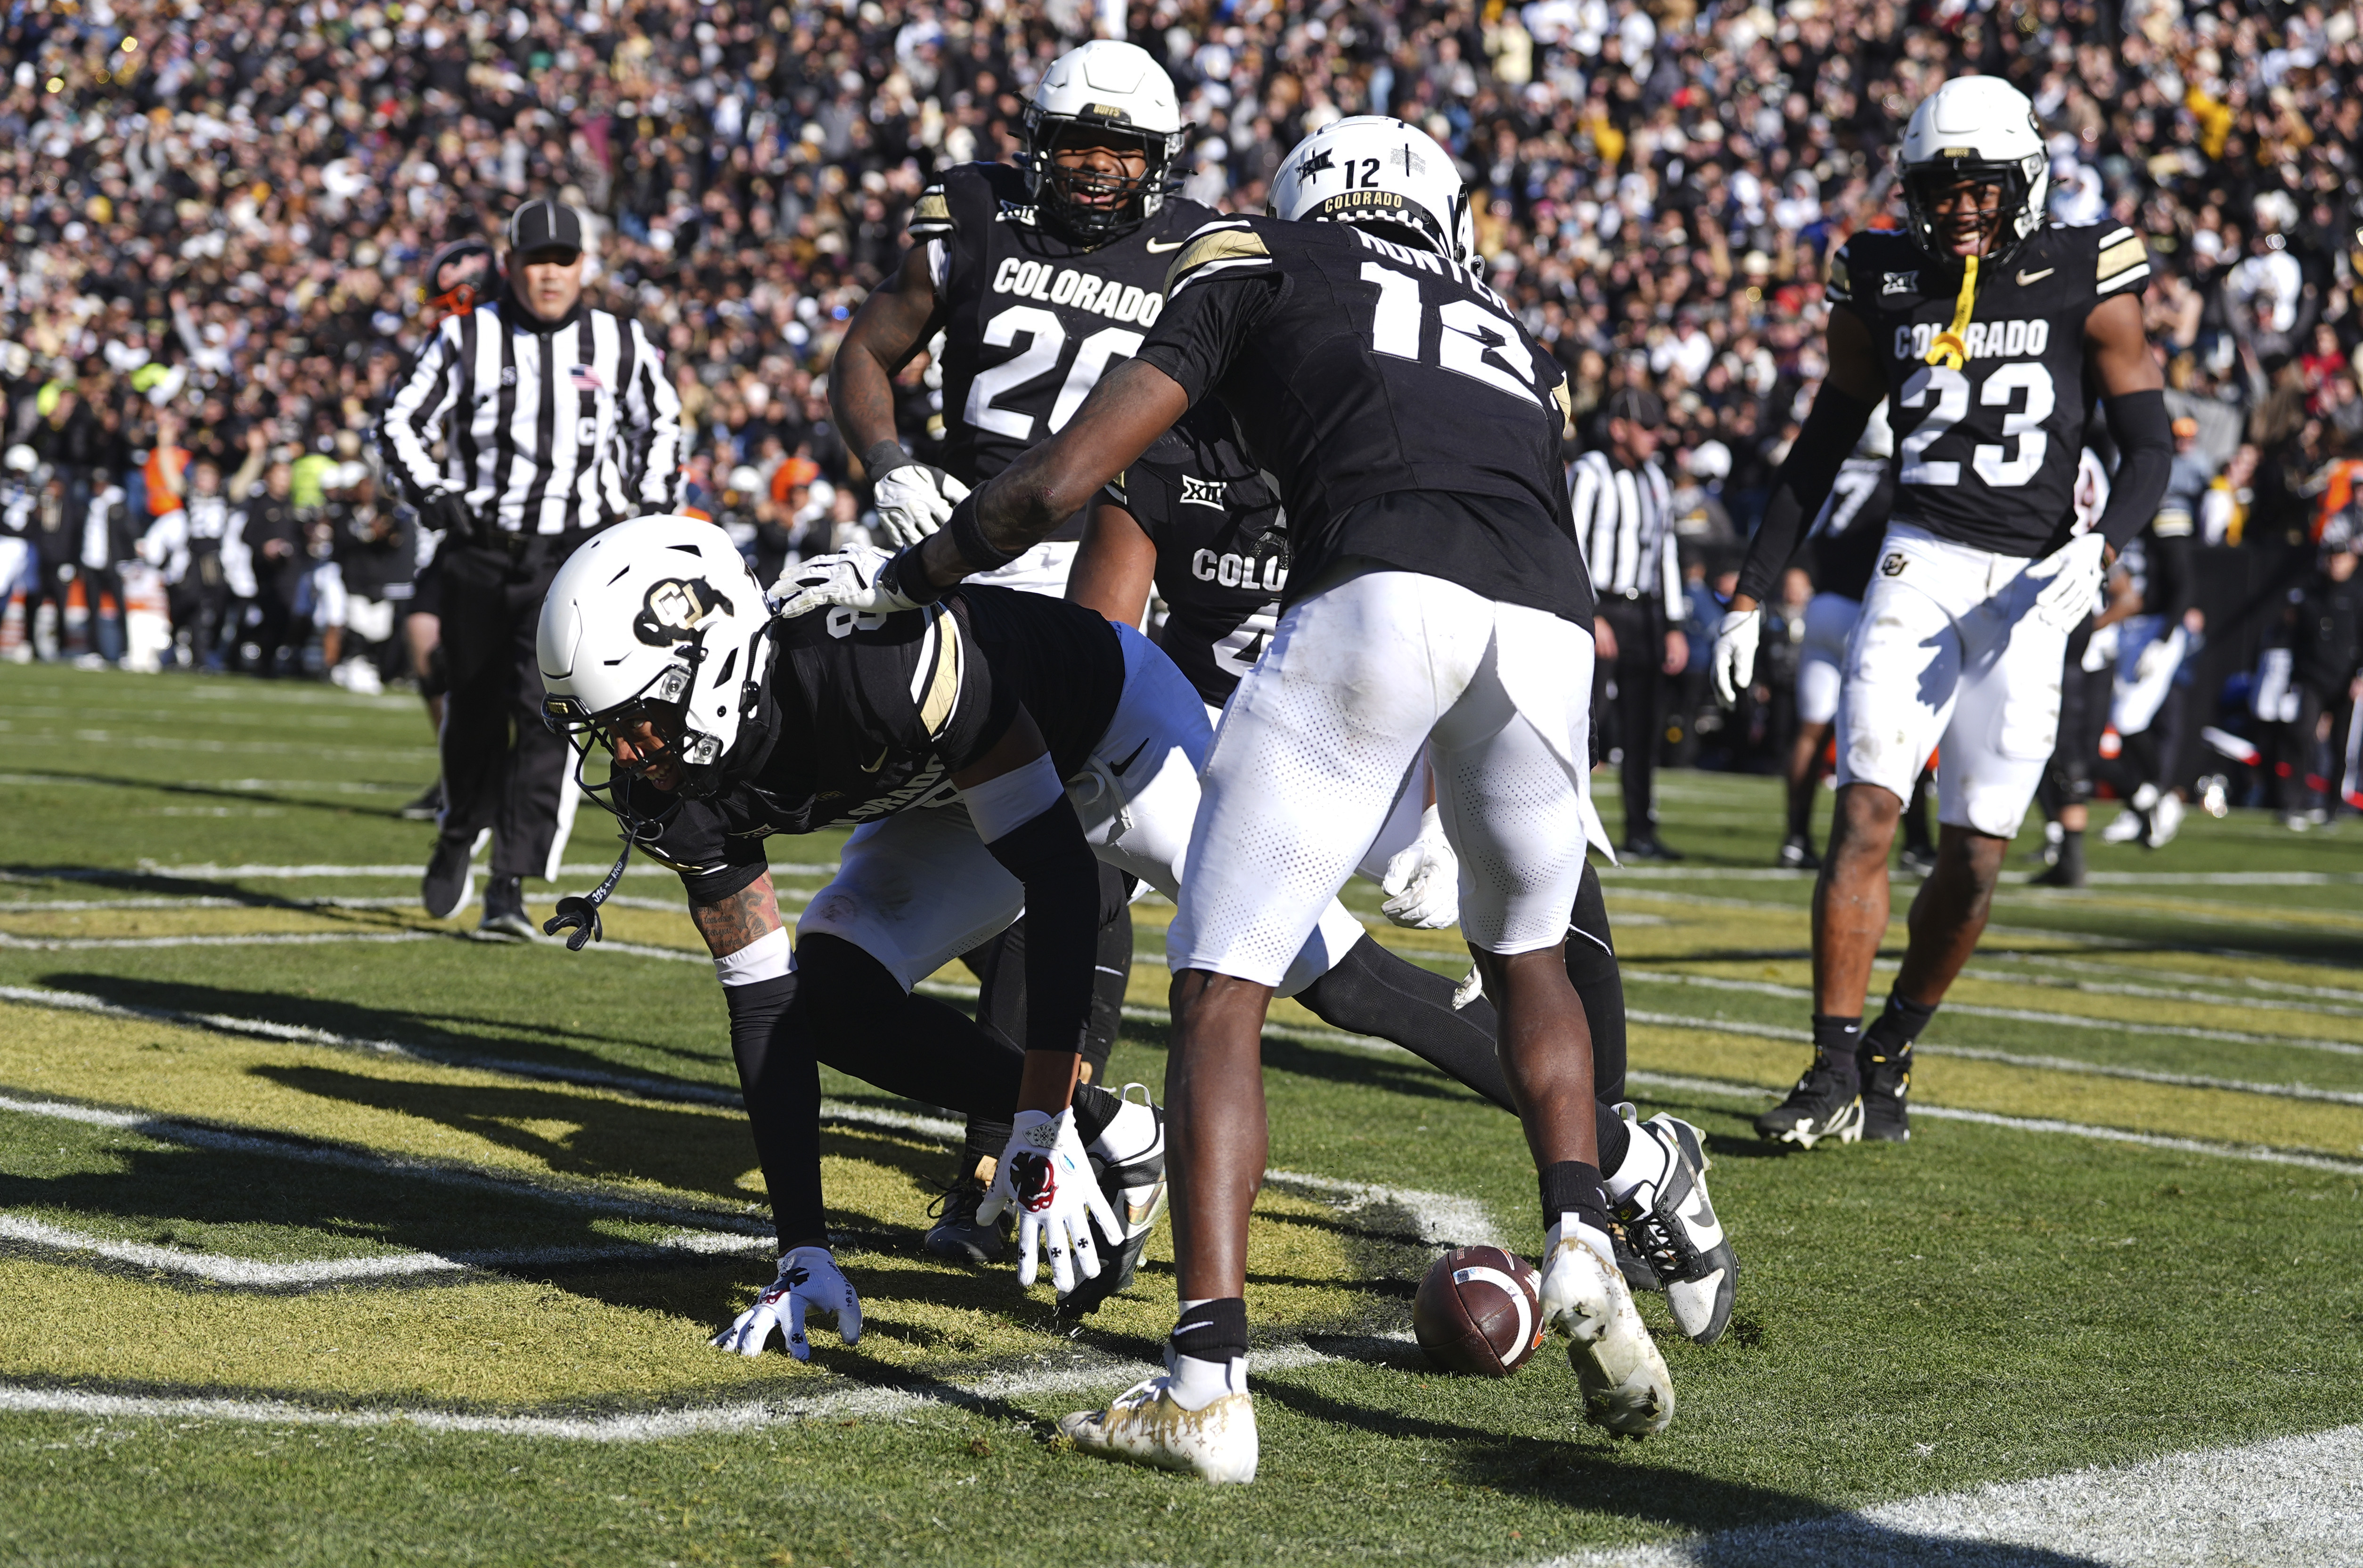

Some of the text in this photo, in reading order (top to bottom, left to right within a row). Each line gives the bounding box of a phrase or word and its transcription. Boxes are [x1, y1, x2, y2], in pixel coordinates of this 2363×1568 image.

[1344, 158, 1380, 189] 12
[1325, 191, 1403, 213] COLORADO
[992, 257, 1164, 328] COLORADO
[1360, 261, 1543, 407] 12
[578, 417, 596, 446] C
[1899, 362, 2055, 487] 23
